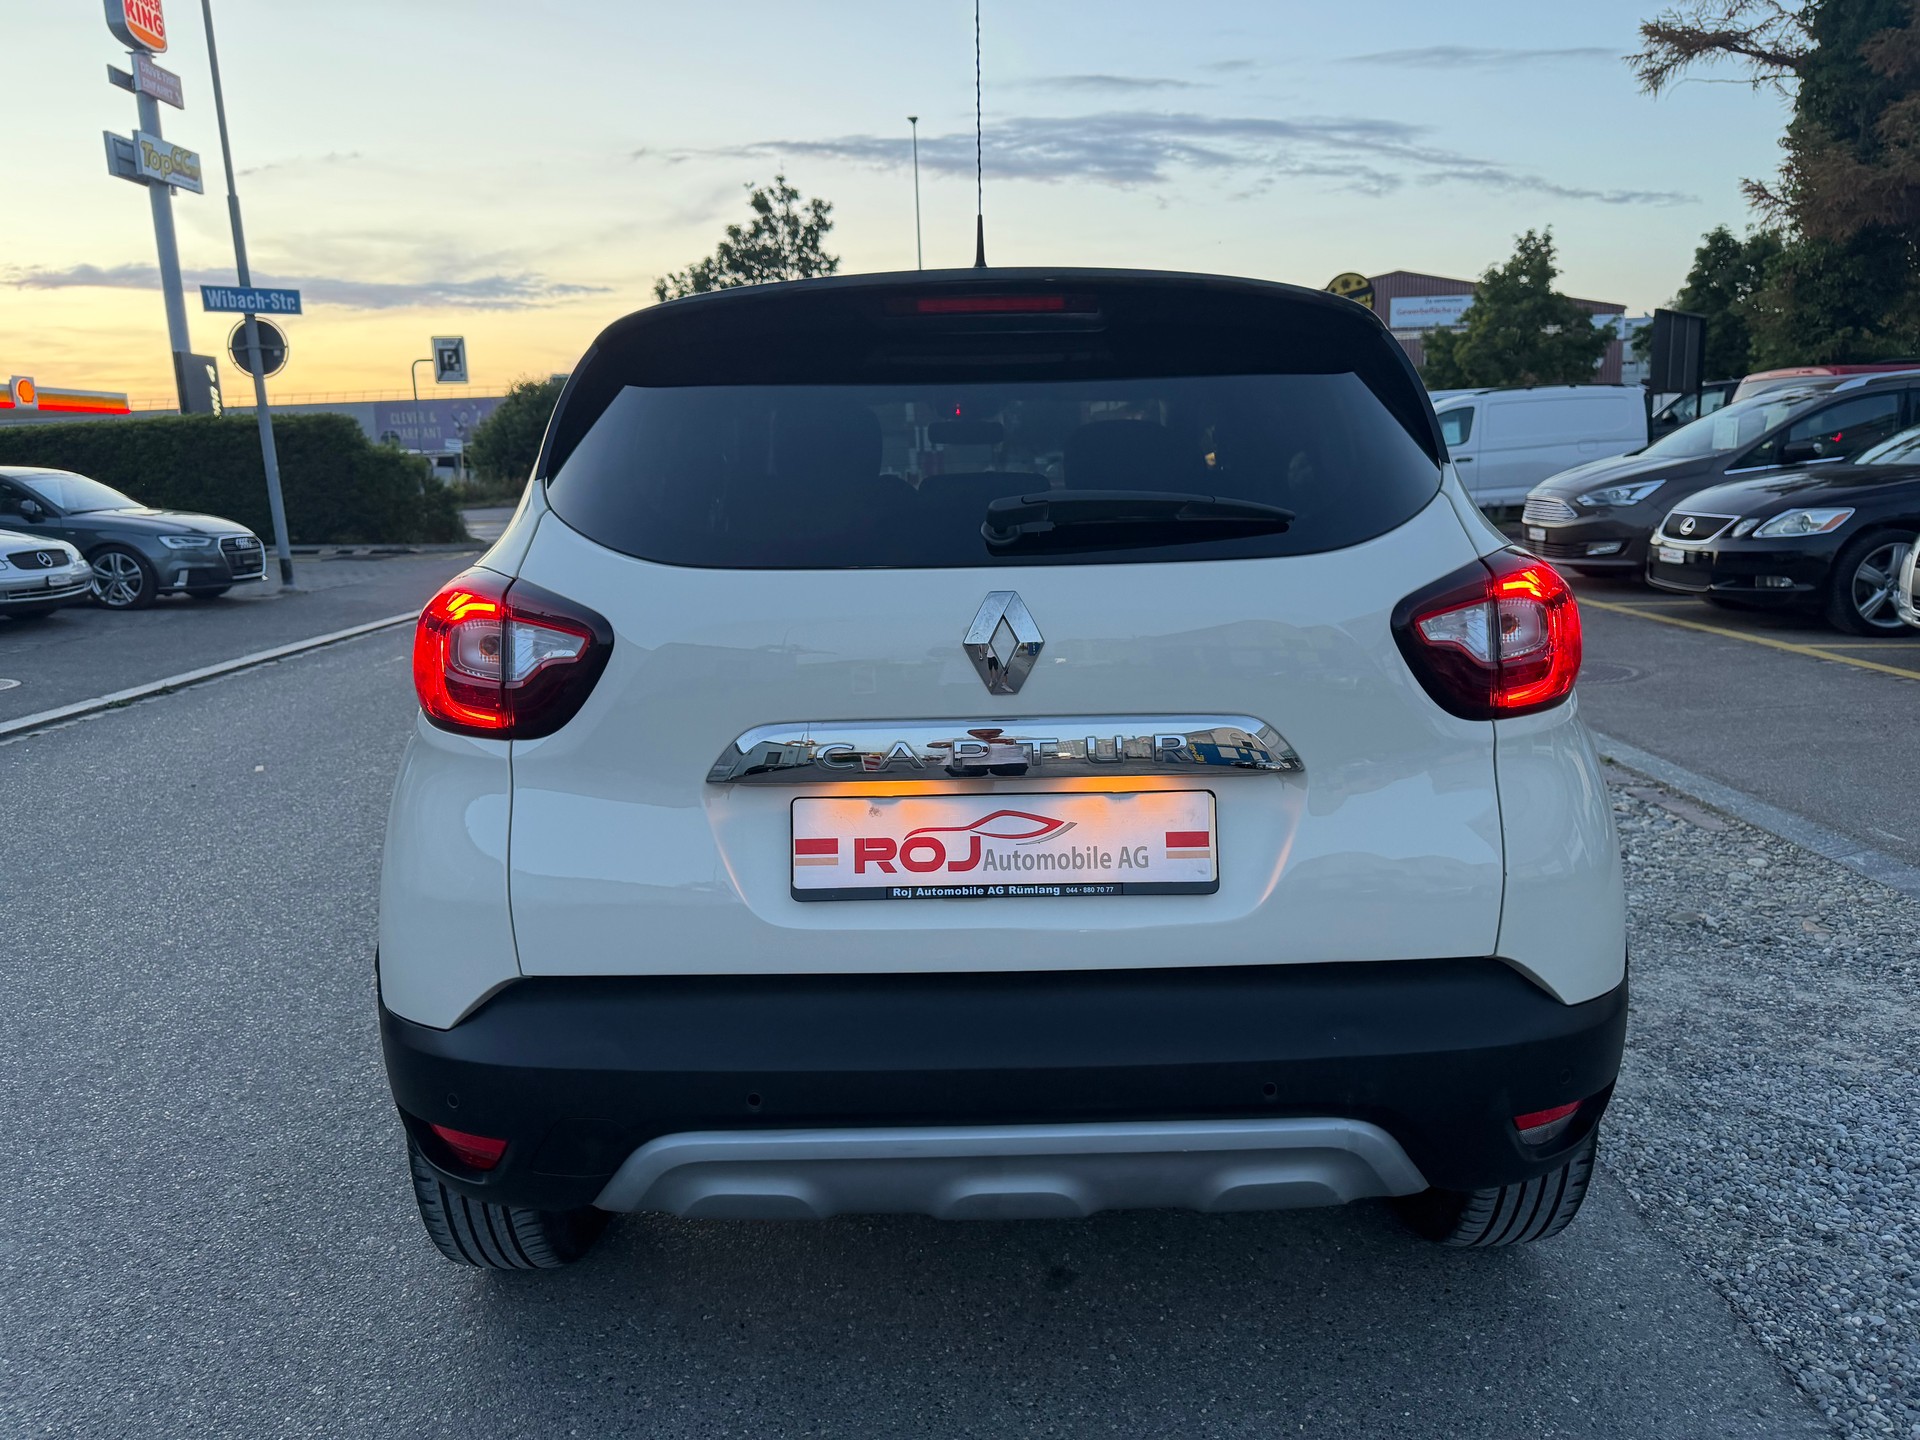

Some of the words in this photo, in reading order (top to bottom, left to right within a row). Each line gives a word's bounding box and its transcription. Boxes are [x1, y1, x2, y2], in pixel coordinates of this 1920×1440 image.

[125, 0, 164, 37] KING
[206, 289, 296, 310] Wibach-Str.
[816, 734, 1192, 771] CAPTUR
[854, 836, 981, 873] ROJ
[983, 846, 1112, 871] Automobile
[1118, 846, 1149, 869] AG
[893, 887, 912, 898] Roj
[916, 886, 984, 896] Automobile
[987, 885, 1004, 895] AG
[1008, 885, 1060, 896] Rümlang
